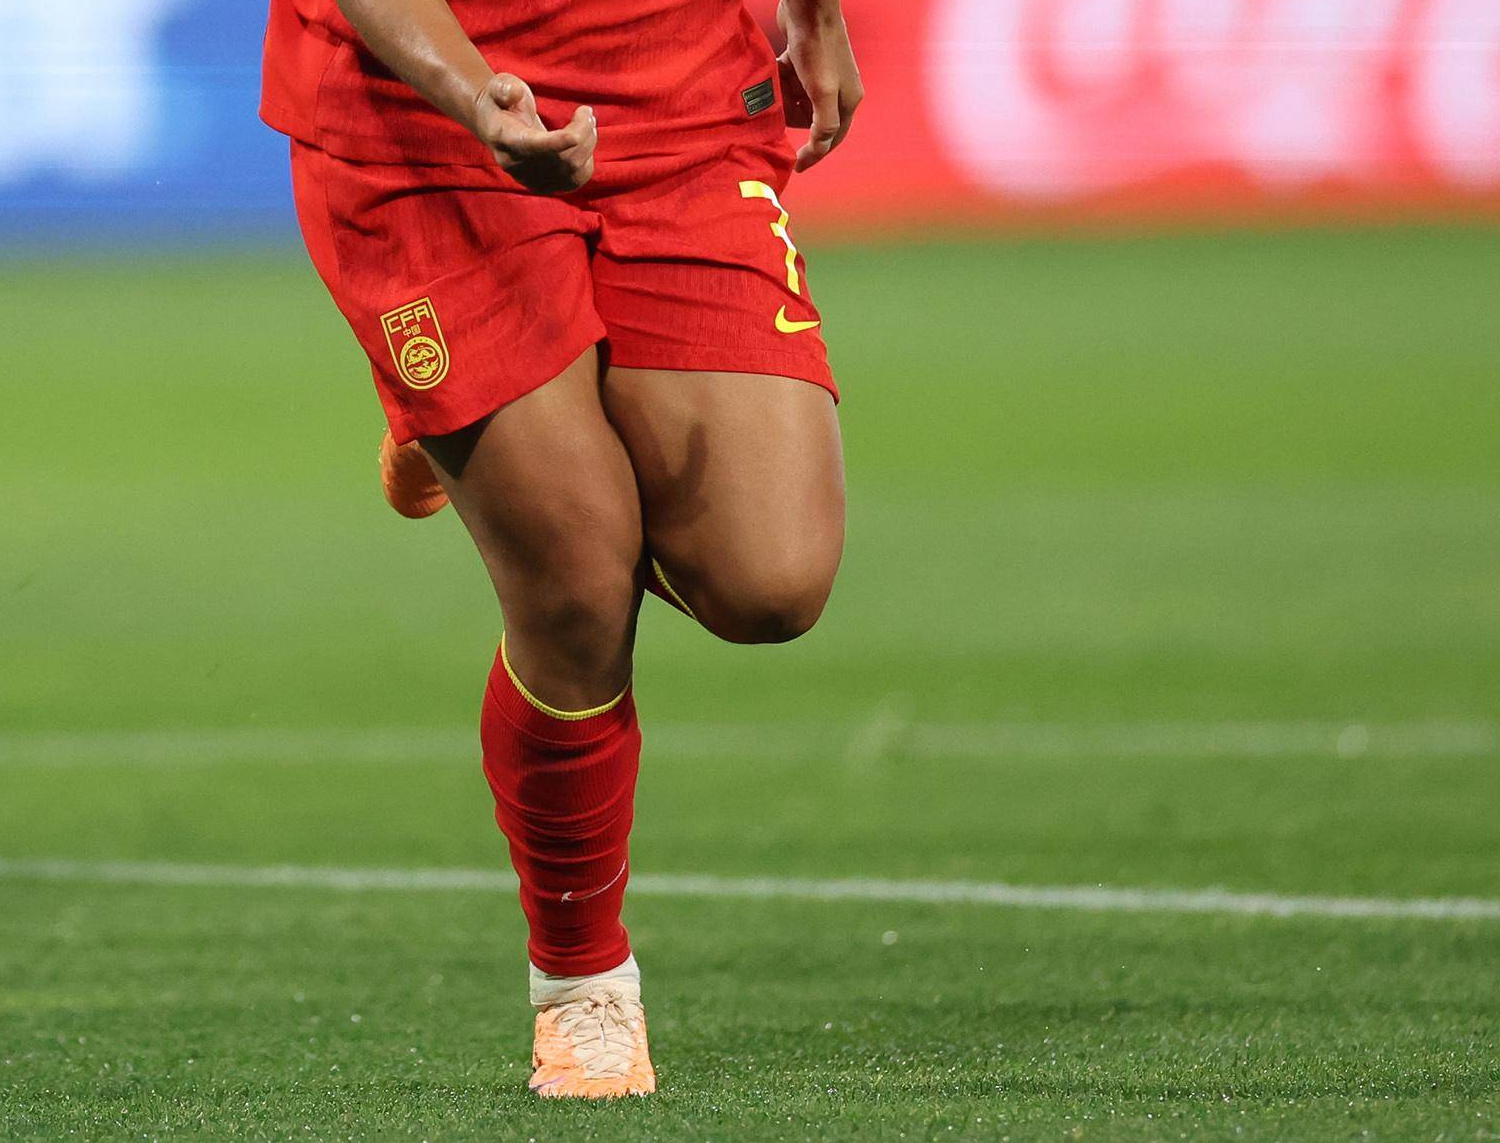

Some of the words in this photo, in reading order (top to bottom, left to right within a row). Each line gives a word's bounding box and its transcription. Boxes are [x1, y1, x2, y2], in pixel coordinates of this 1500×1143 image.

[738, 180, 800, 295] 7
[386, 304, 431, 334] CFA
[402, 324, 421, 337] 中国
